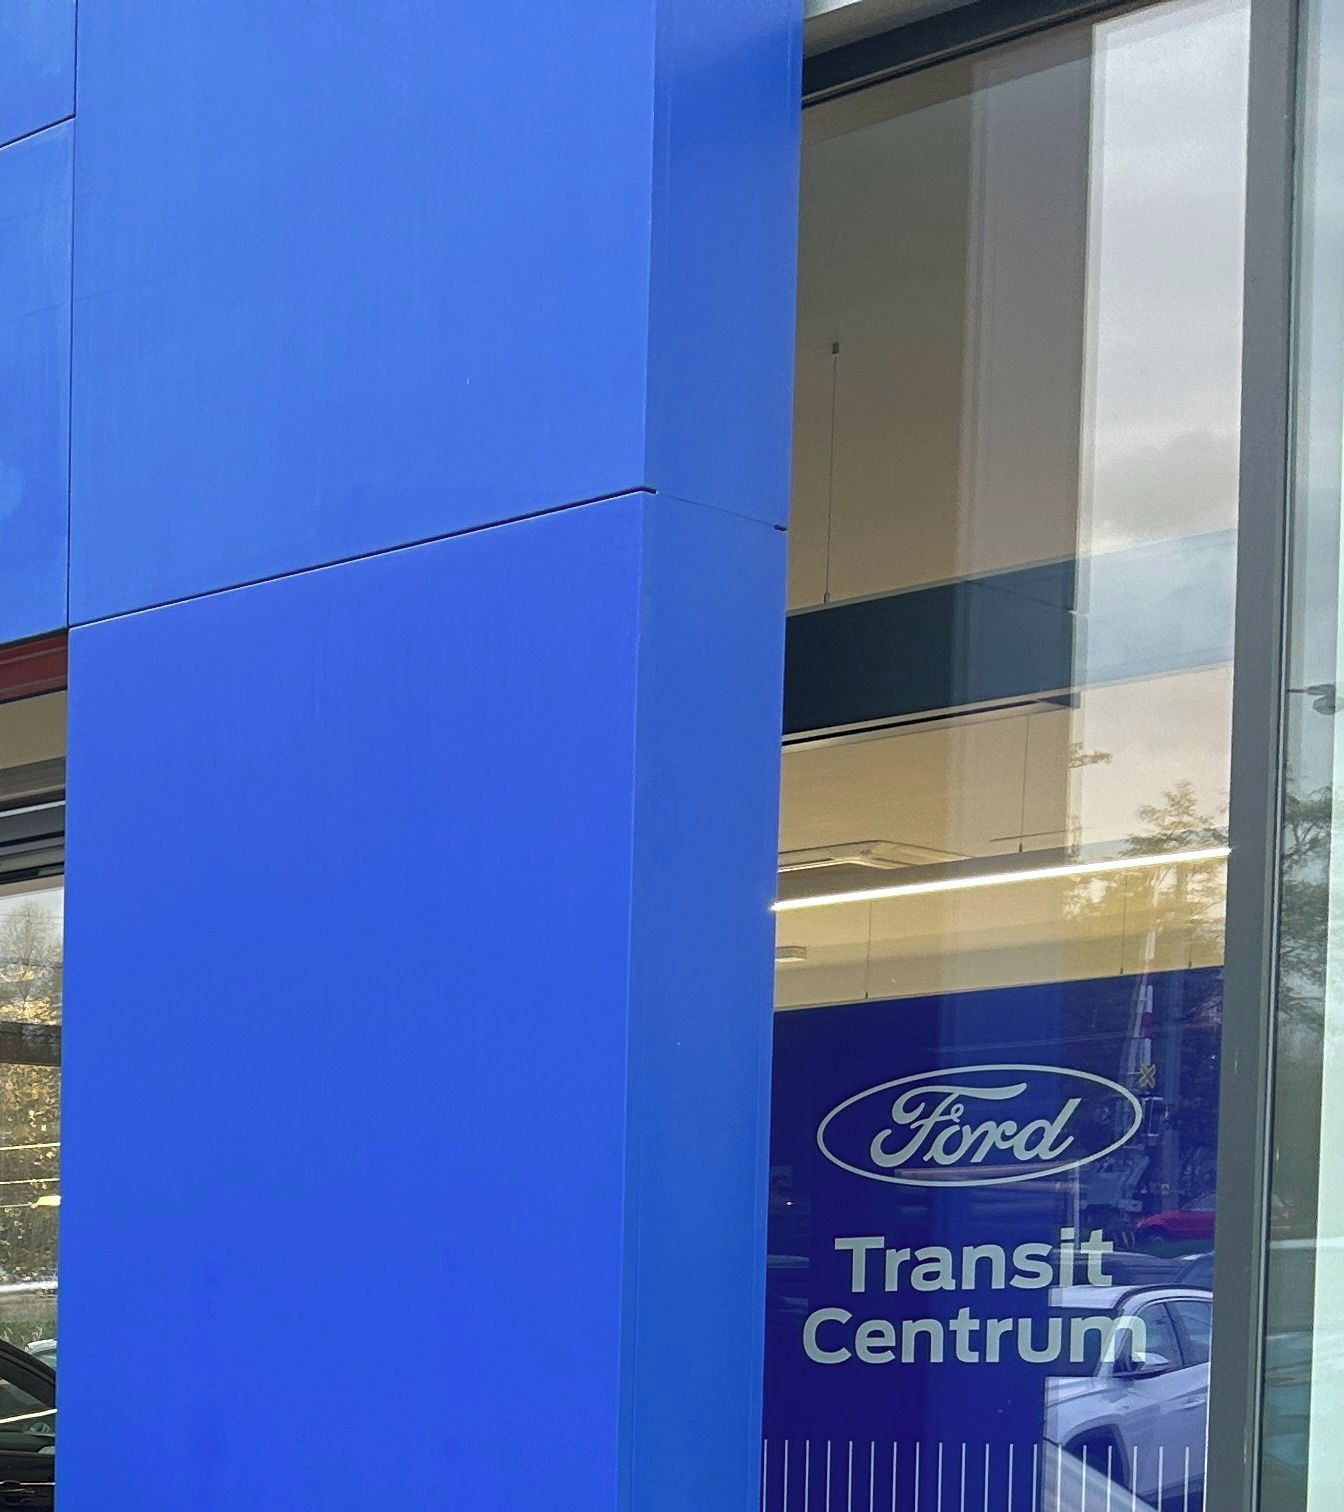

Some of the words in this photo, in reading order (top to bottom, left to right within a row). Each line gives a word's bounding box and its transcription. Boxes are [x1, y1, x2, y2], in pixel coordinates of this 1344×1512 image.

[869, 1081, 1083, 1168] Ford
[834, 1227, 1116, 1294] Transit
[802, 1305, 1147, 1365] Centrum
